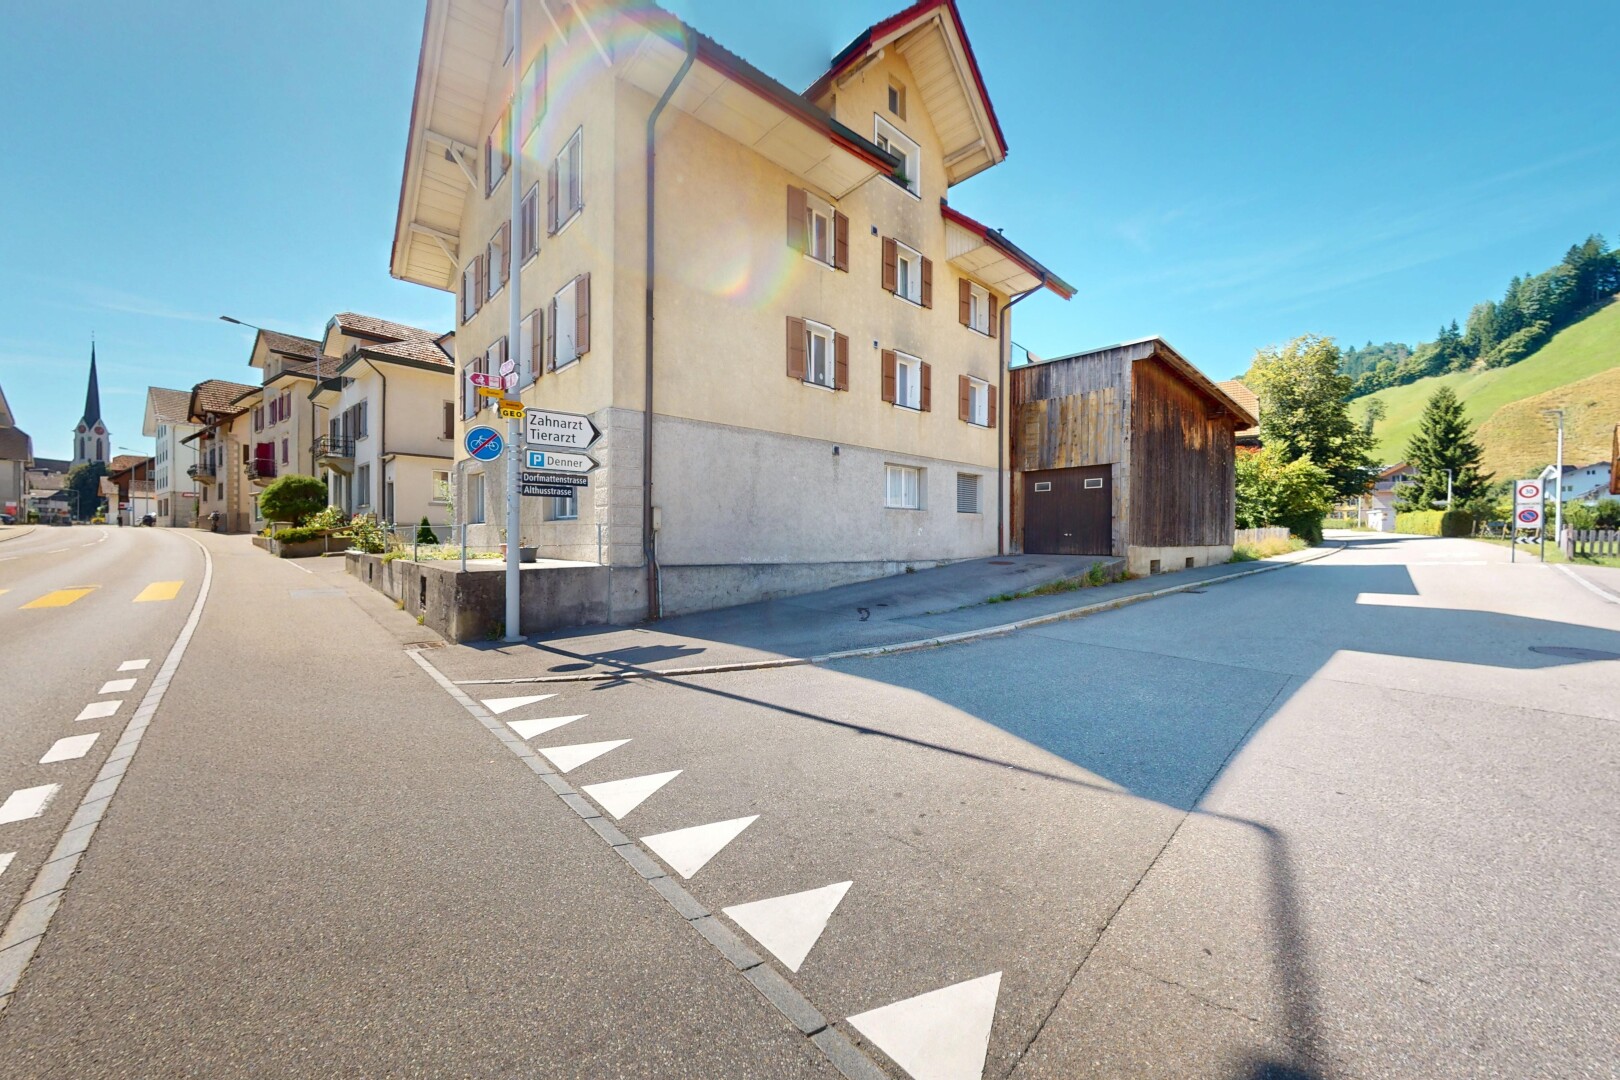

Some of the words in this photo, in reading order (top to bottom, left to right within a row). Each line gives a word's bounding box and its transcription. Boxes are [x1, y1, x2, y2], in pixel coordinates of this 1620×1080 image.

[530, 414, 582, 430] Zahnarzt
[530, 429, 576, 443] Tierarzt
[534, 455, 542, 466] P
[547, 456, 583, 468] Denner
[523, 473, 587, 485] Dorfmattenstrasse
[523, 485, 572, 496] Althusstrasse
